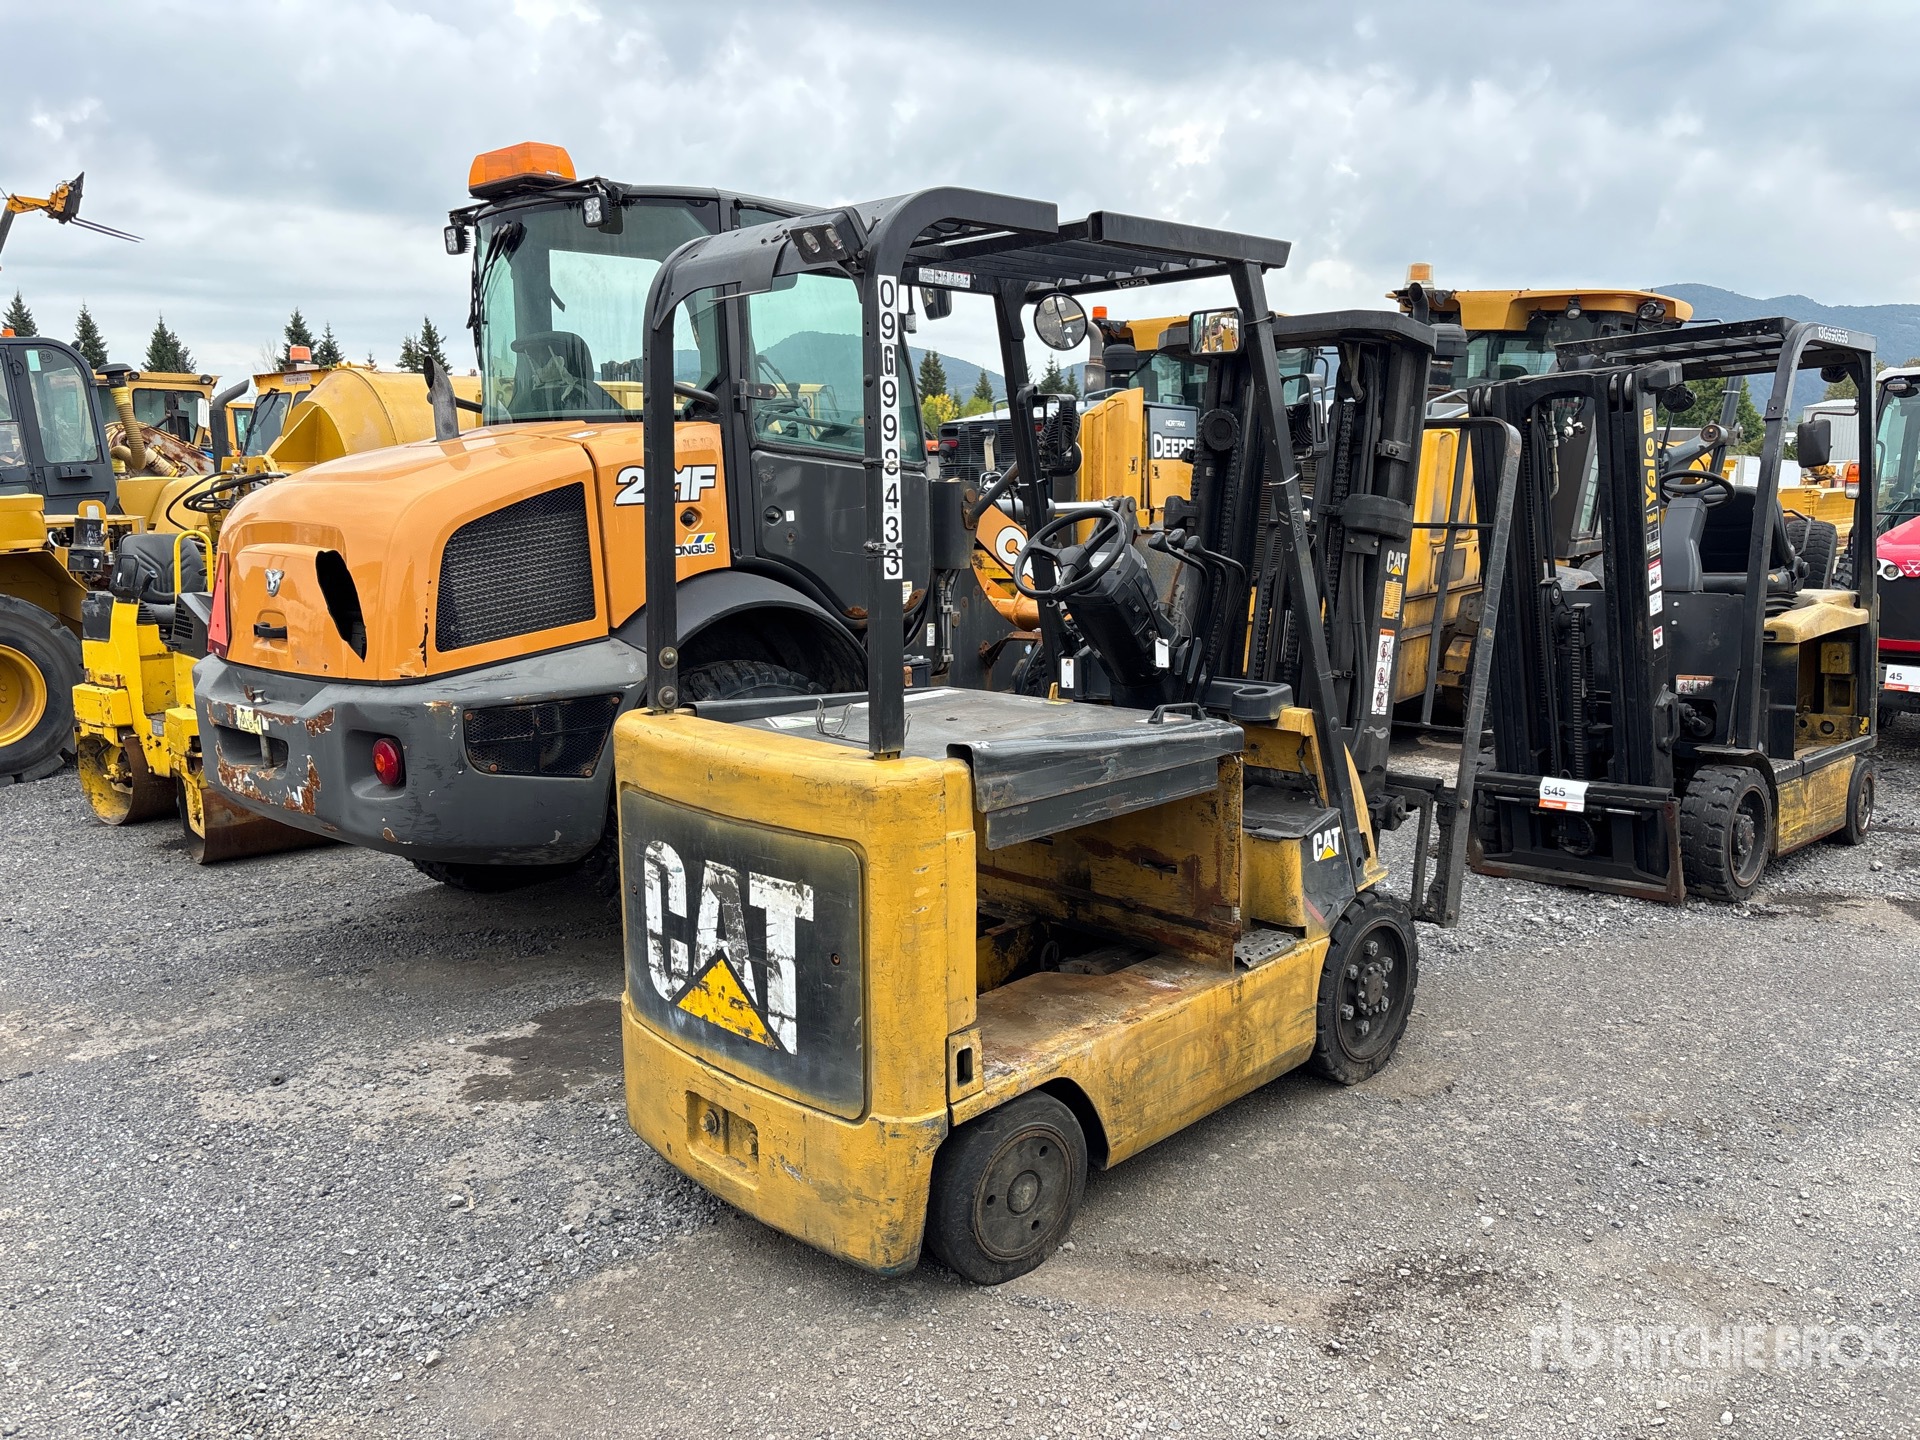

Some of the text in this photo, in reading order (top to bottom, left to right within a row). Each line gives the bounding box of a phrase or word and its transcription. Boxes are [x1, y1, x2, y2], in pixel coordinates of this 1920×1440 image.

[614, 465, 717, 507] 21F
[1644, 437, 1657, 508] Yale
[1386, 549, 1408, 576] CAT
[1888, 672, 1903, 681] 45
[1543, 785, 1566, 797] 545
[1312, 826, 1341, 862] CAT
[643, 840, 814, 1055] CAT
